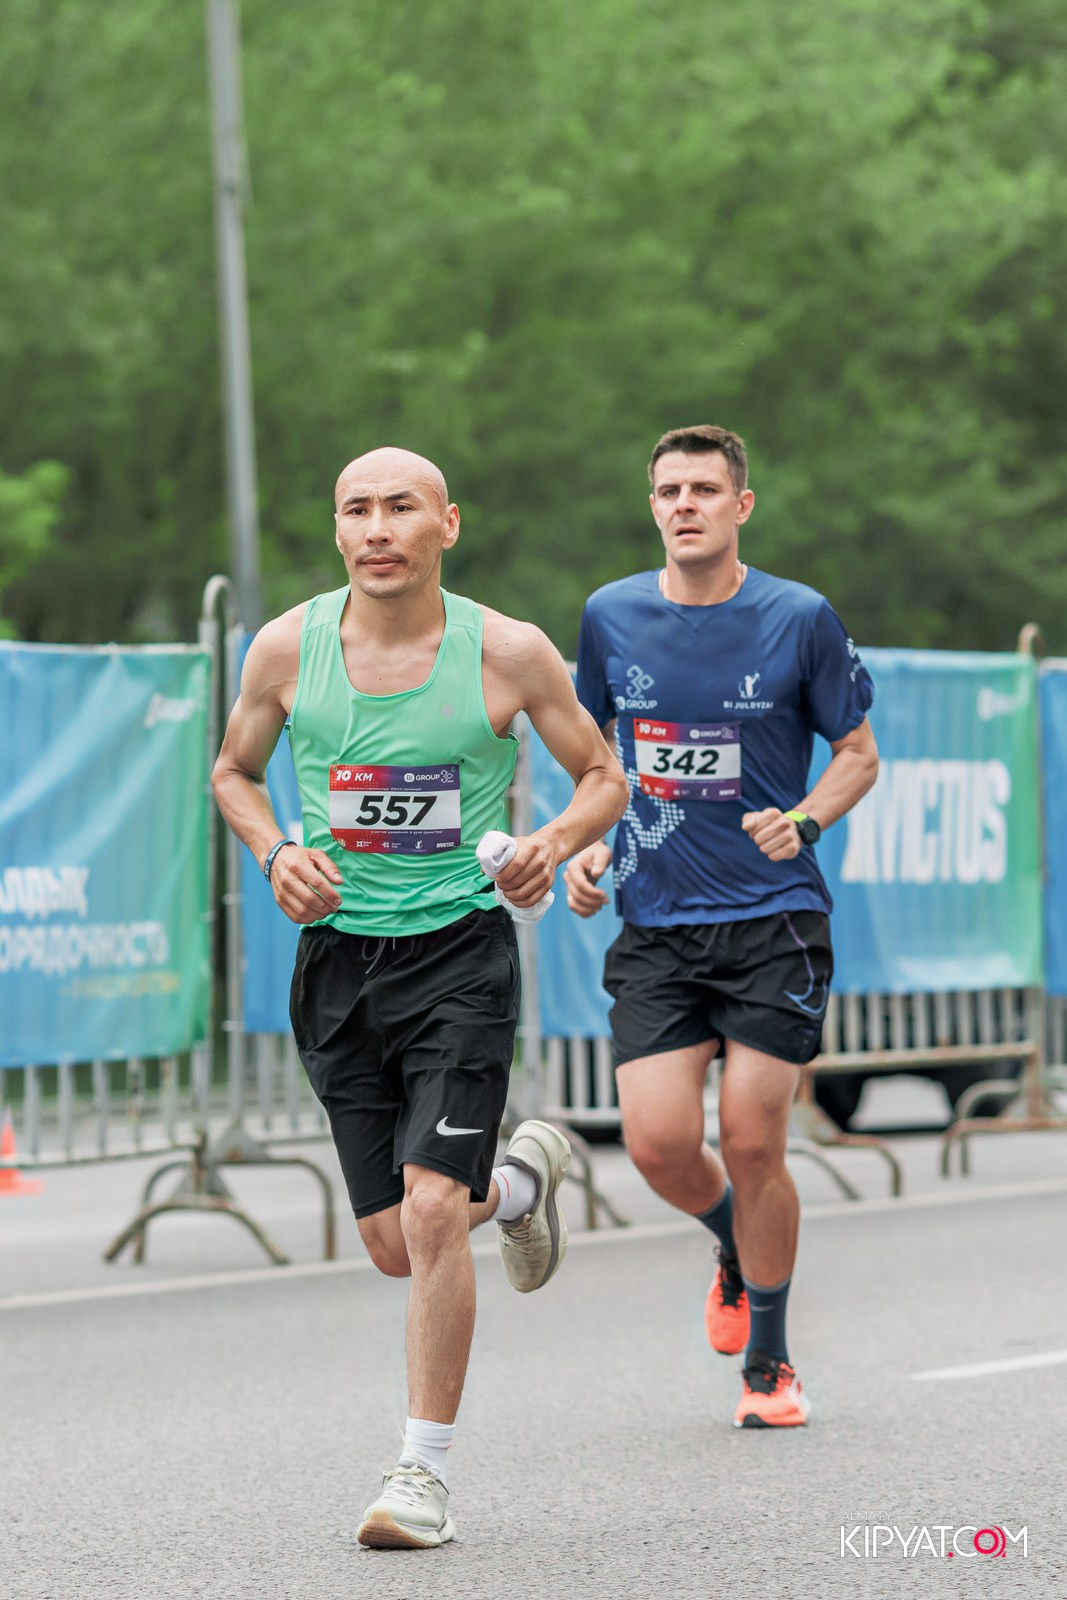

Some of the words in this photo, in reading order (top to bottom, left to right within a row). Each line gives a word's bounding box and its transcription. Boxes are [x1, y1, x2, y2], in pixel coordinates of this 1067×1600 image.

[626, 699, 658, 710] GROUP
[639, 723, 651, 734] 10
[652, 747, 720, 775] 342
[336, 770, 352, 782] 10
[355, 795, 438, 826] 557
